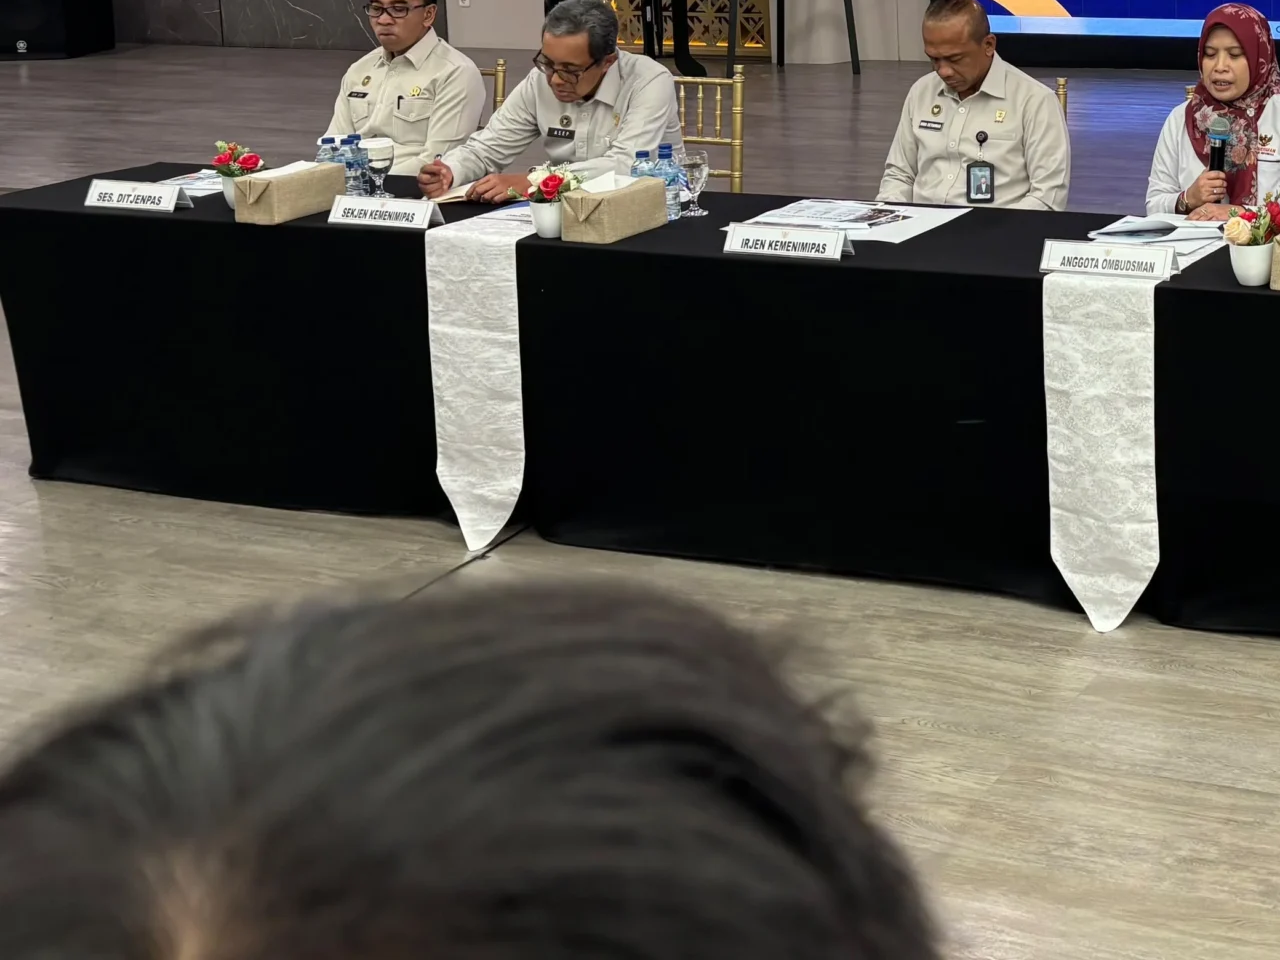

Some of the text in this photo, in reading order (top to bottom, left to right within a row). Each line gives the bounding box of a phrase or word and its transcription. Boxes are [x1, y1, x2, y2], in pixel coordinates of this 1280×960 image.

[97, 192, 162, 206] SES. DITJENPAS
[341, 207, 416, 223] SEKJEN KEMENIMIPAS
[741, 238, 827, 254] IRJEN KEMENIMIPAS
[1060, 256, 1156, 273] ANGGOTA OMBUDSMAN
